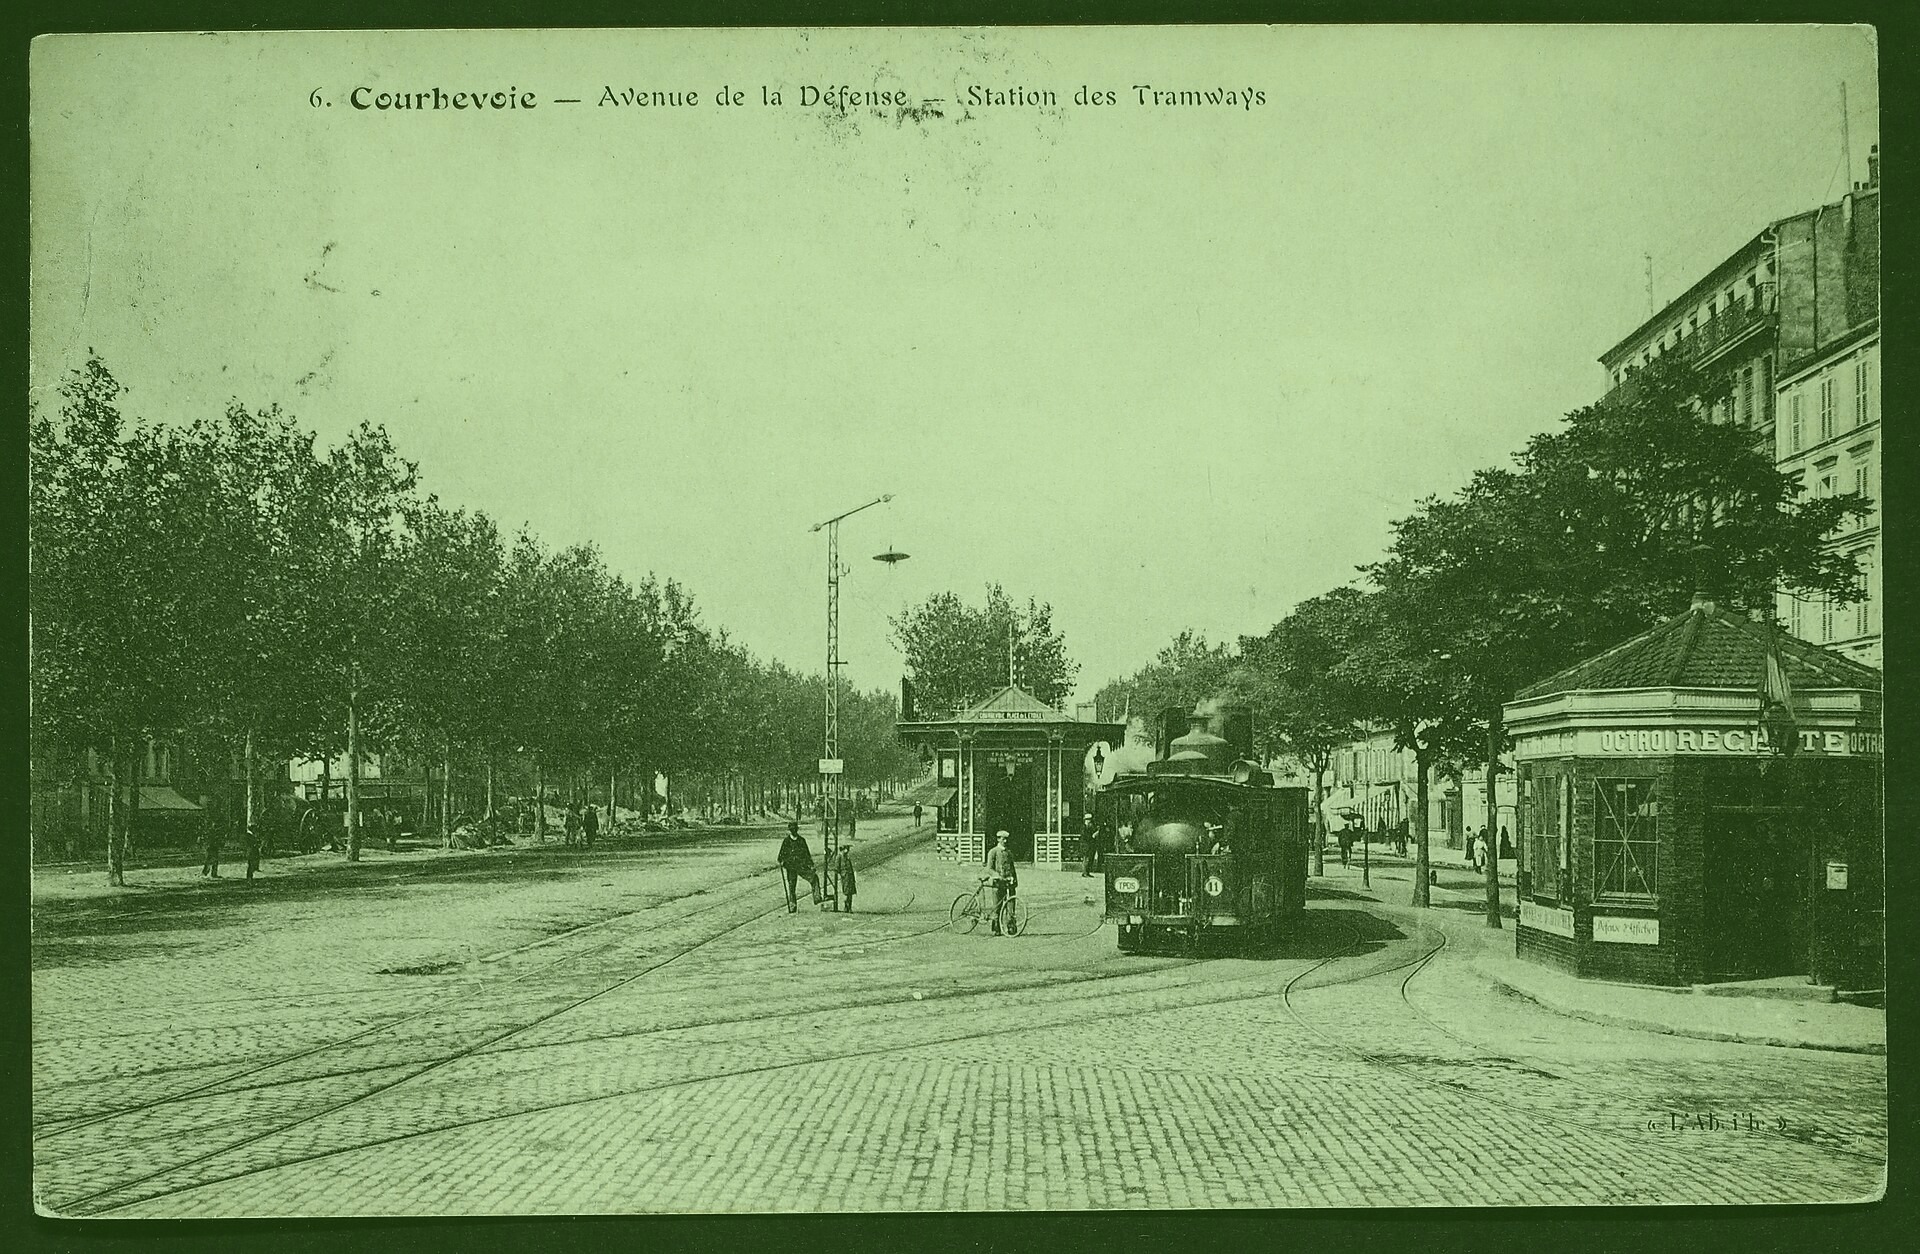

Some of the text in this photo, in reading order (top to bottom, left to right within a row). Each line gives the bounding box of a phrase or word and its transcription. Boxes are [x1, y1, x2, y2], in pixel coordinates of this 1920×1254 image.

[1601, 729, 1671, 752] OCTROI
[1676, 729, 1846, 752] RECETE
[1208, 881, 1219, 892] 11
